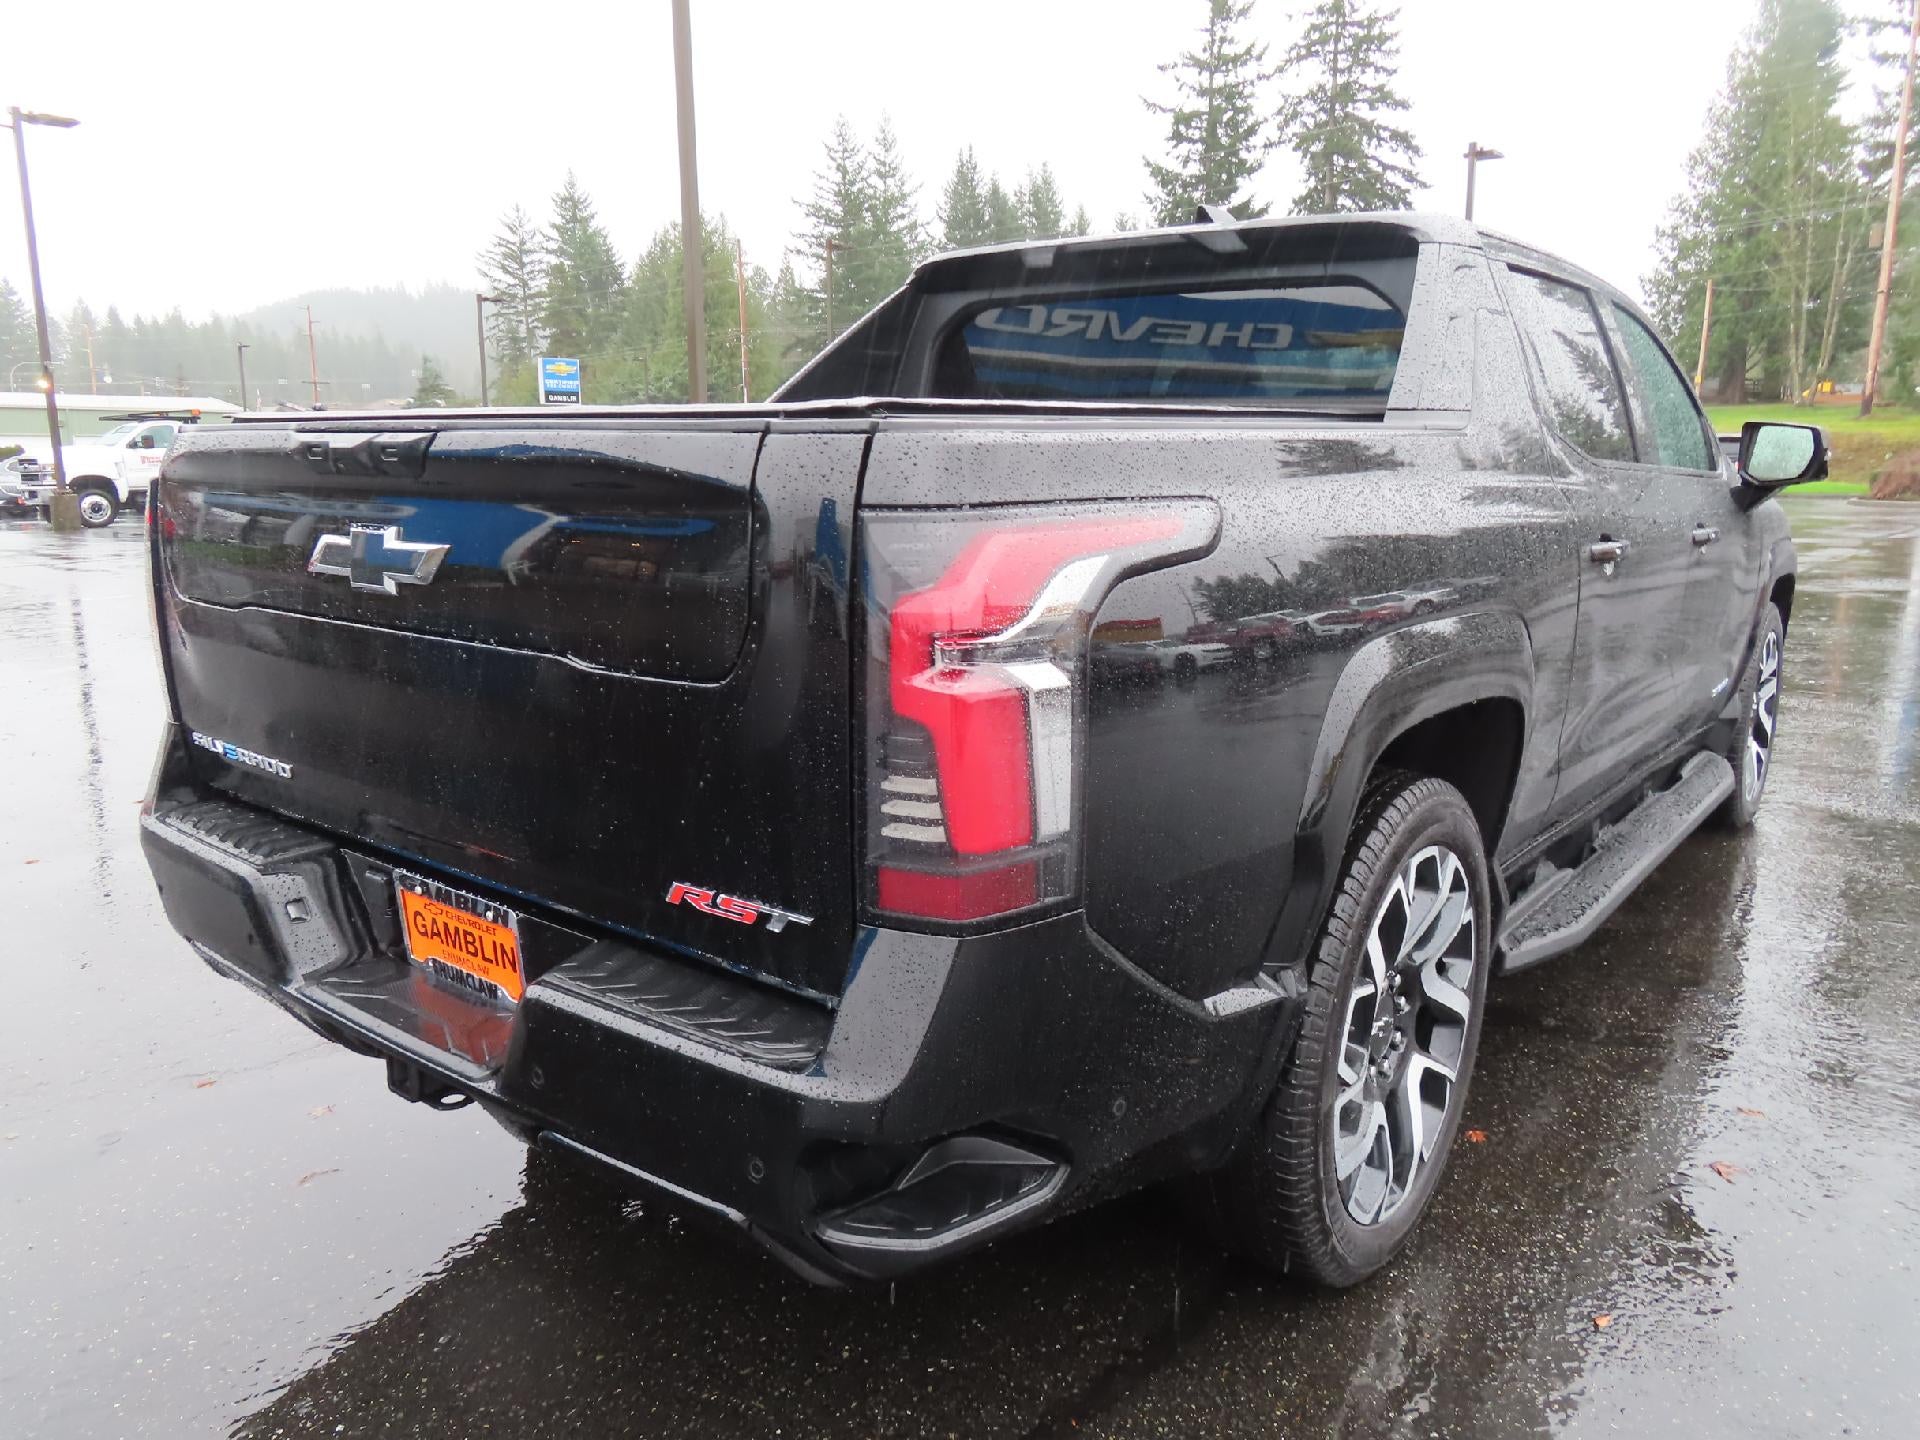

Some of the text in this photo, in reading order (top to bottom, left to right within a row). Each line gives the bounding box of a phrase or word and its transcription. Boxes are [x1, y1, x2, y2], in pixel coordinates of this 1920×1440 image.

[192, 731, 293, 778] SILVERADO
[413, 910, 518, 974] GAMBLIN
[445, 909, 497, 936] CHEVROLET
